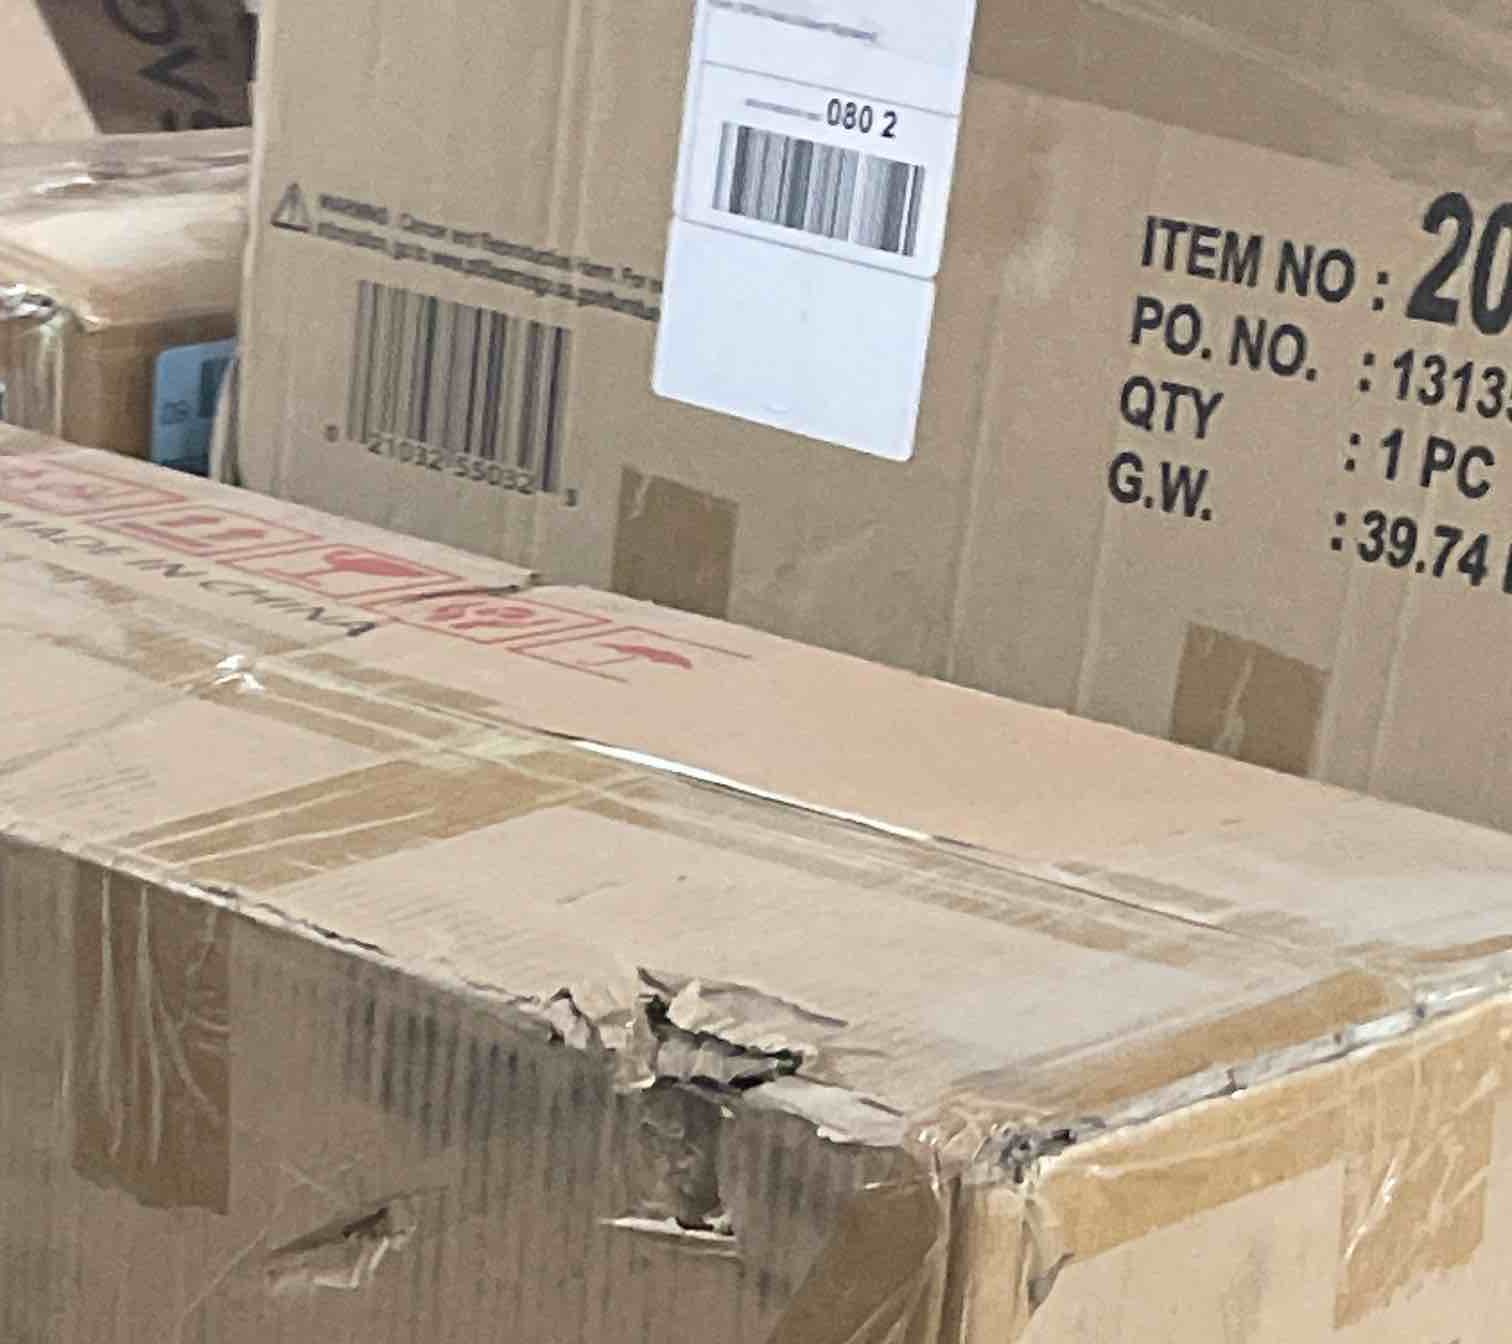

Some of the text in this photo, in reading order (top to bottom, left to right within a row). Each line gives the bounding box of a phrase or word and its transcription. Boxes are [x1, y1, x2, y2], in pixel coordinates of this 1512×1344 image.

[827, 98, 874, 133] 080
[880, 110, 898, 138] 2
[1141, 215, 1263, 288] ITEM
[1274, 239, 1356, 303] NO
[1130, 295, 1212, 360] PO.
[1228, 315, 1317, 381] NO.
[1392, 349, 1512, 422] 1313
[1120, 375, 1224, 439] QTY
[1420, 435, 1496, 498] PC
[1108, 451, 1213, 521] G.W.
[126, 559, 210, 581] IN
[199, 580, 377, 637] CHINA
